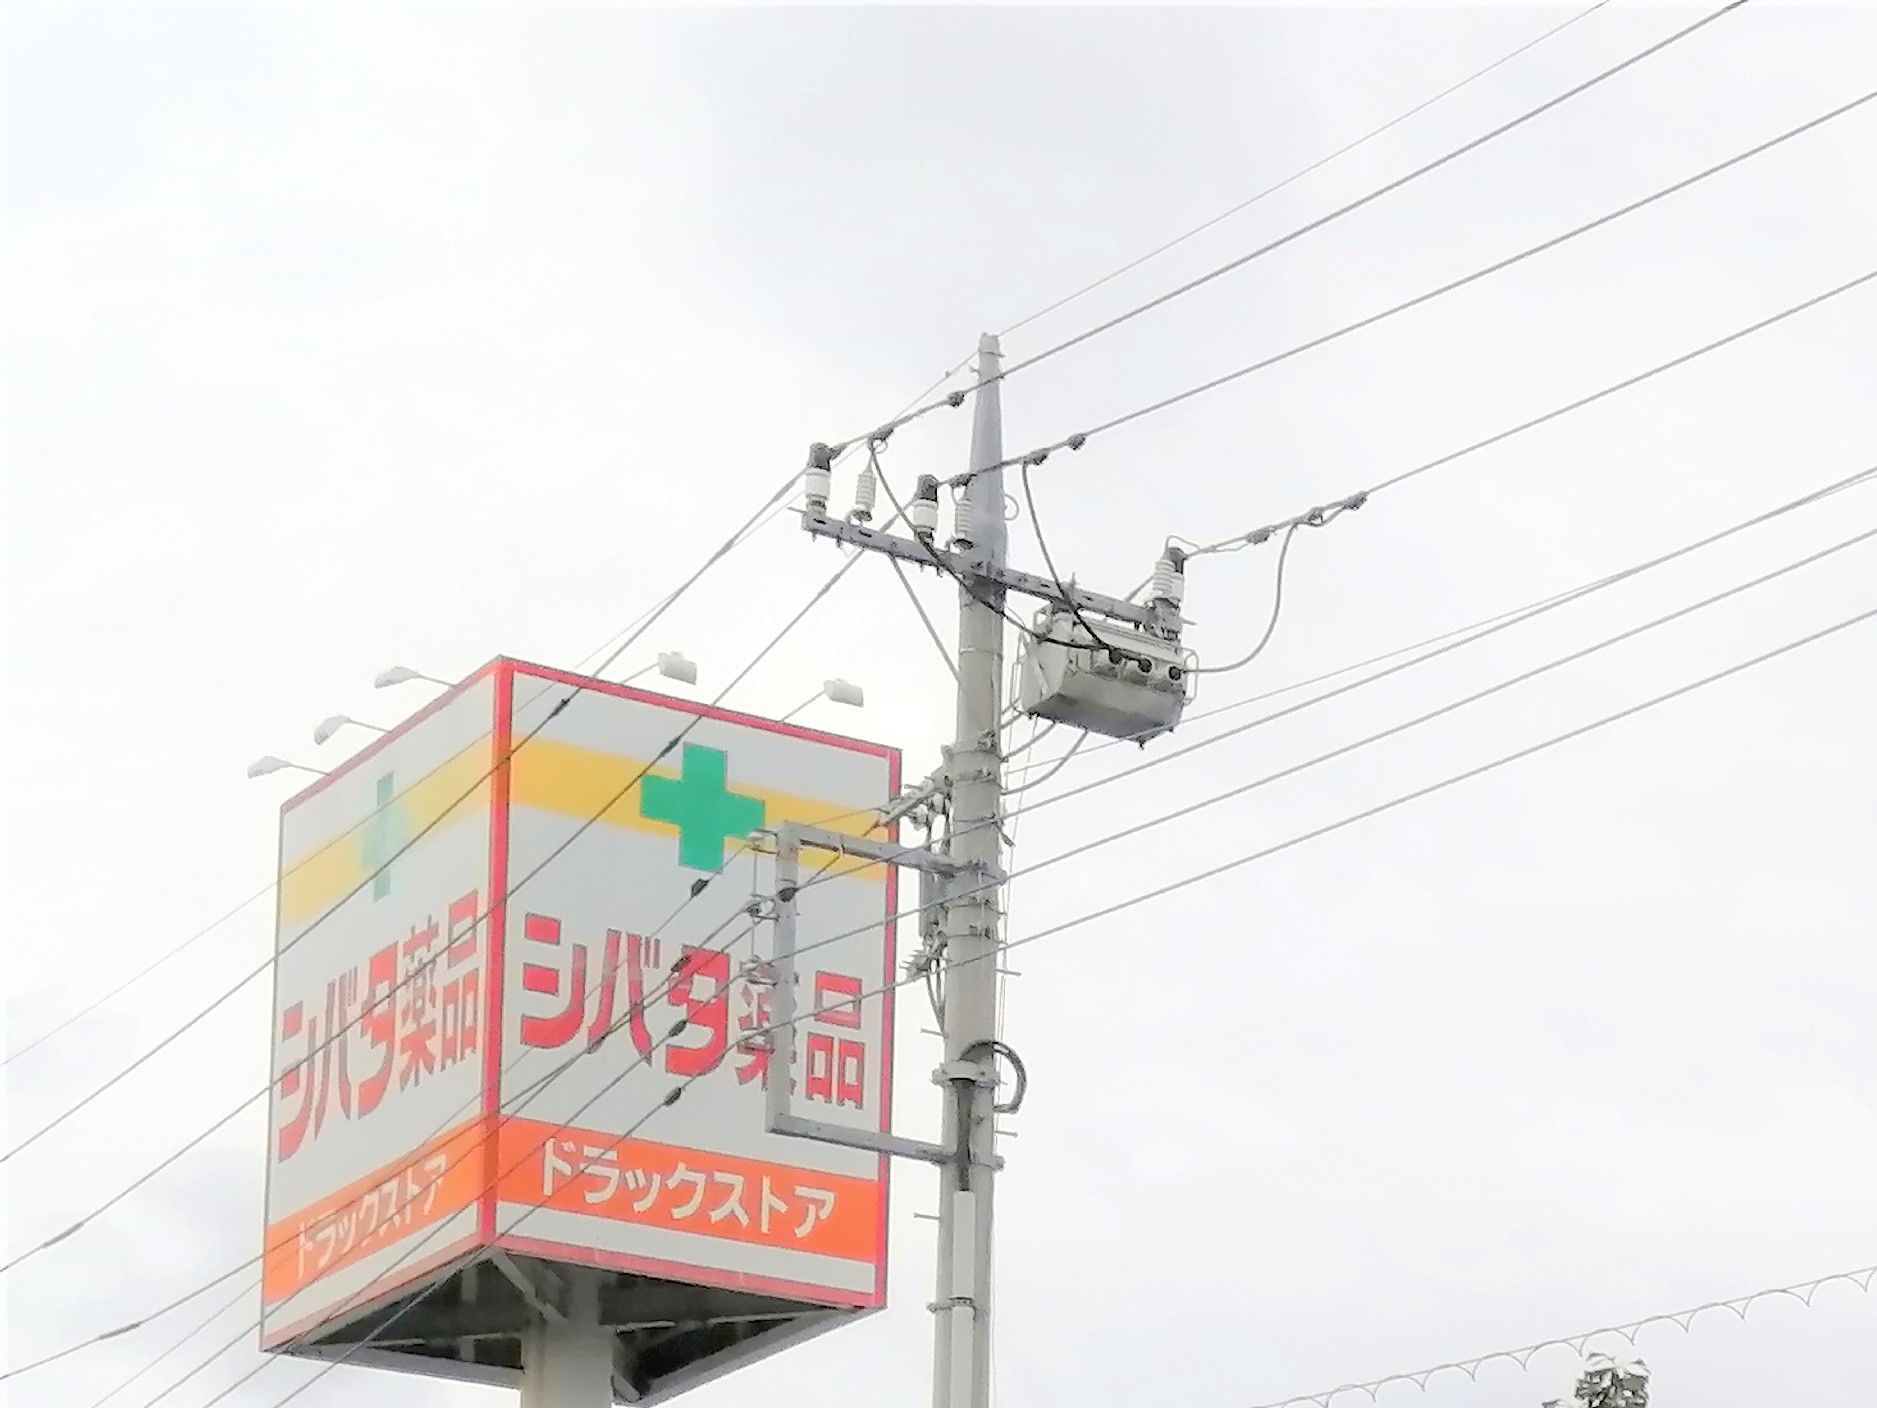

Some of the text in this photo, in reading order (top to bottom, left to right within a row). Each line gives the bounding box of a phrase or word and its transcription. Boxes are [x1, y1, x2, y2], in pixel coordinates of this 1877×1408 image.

[278, 889, 479, 1164] シバタ薬品
[542, 1137, 837, 1238] ドラックストア
